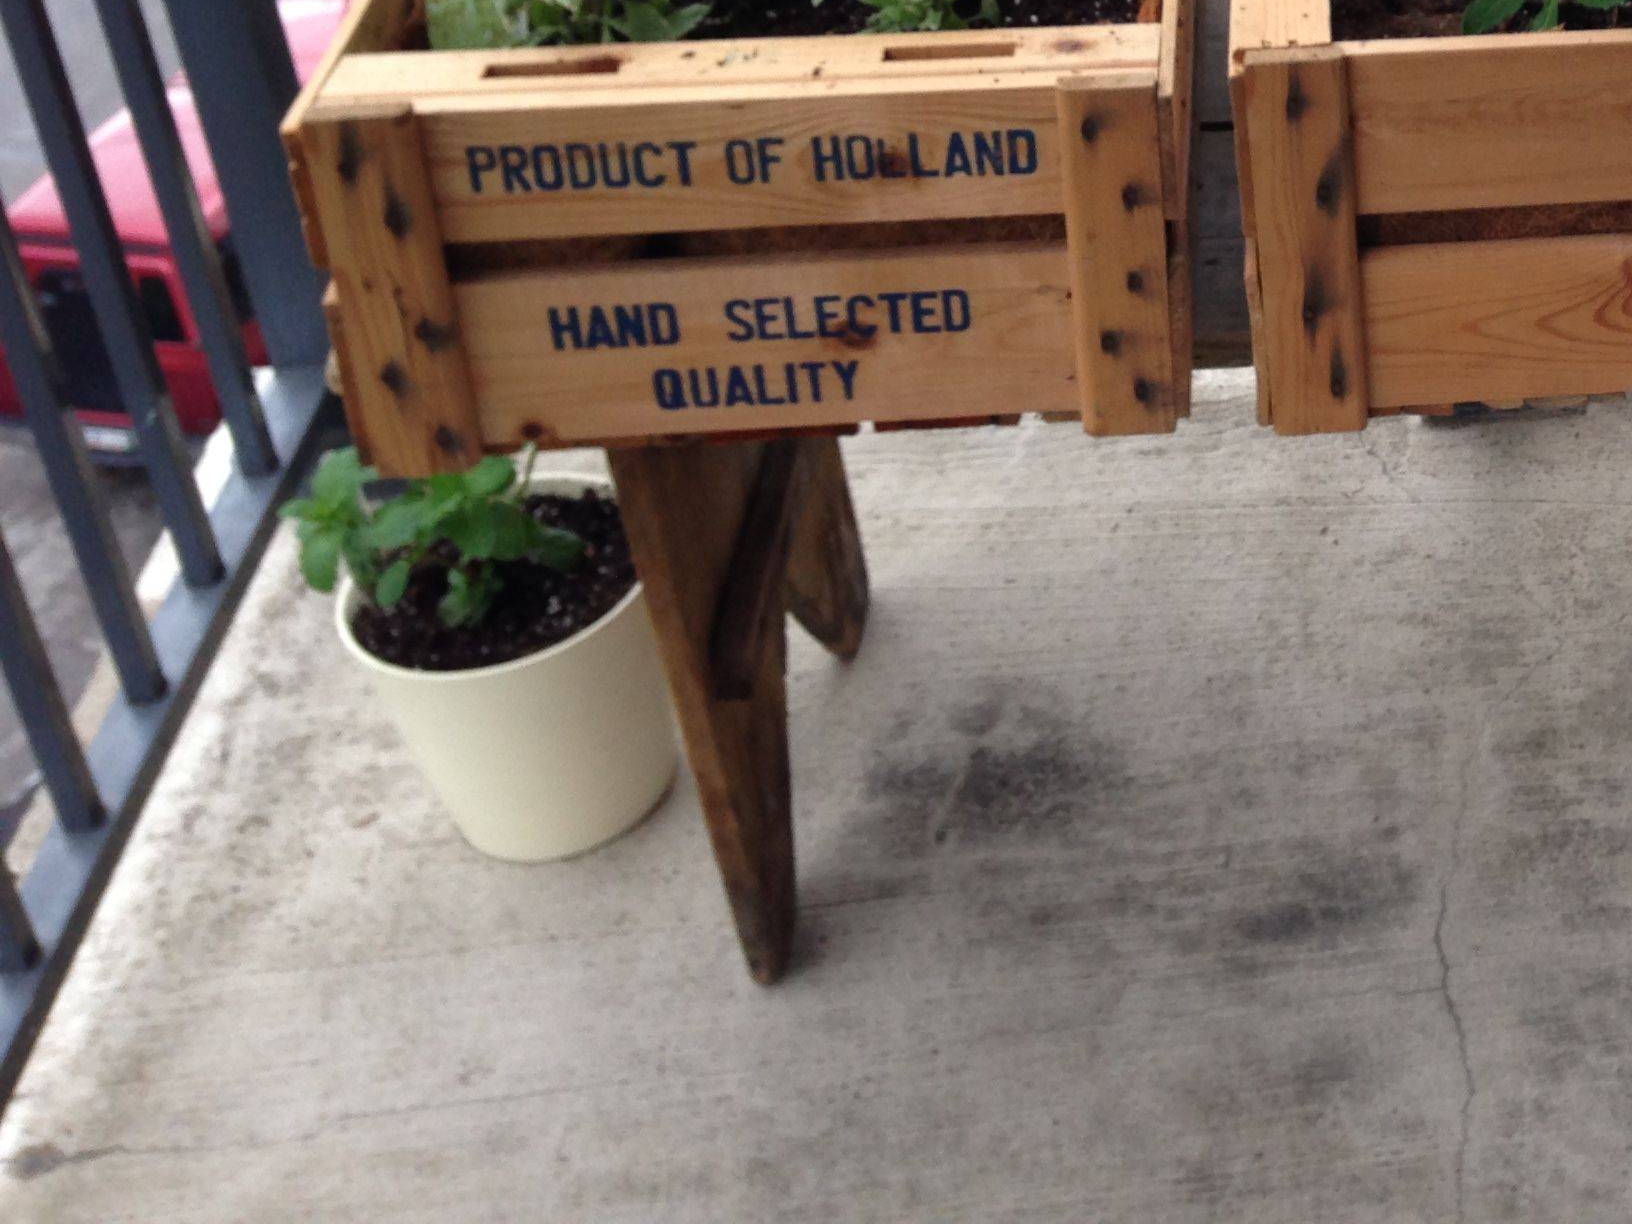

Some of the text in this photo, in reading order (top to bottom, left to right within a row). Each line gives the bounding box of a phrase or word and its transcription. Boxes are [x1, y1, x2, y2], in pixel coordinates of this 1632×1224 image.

[465, 129, 1039, 194] PRODUCT OF HOLLAND
[547, 289, 972, 352] HAND SELECTED
[652, 360, 860, 411] QUALITY
